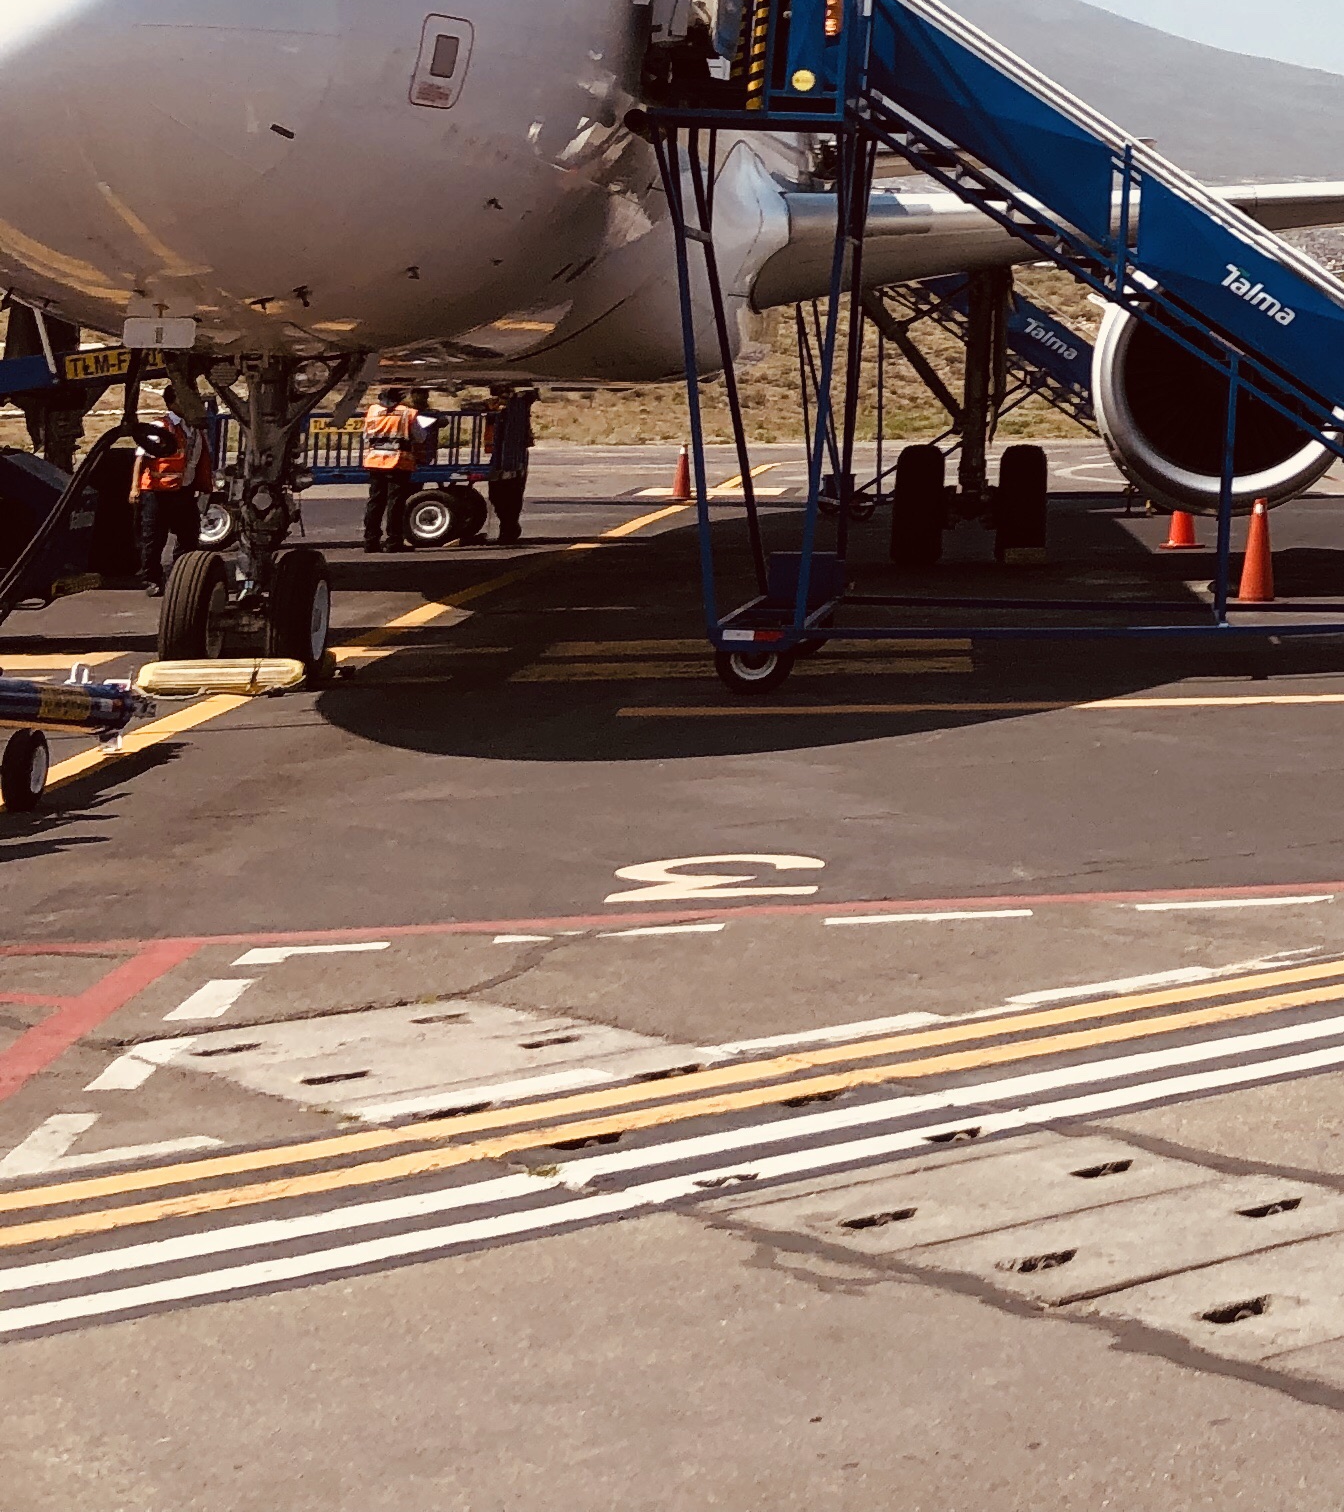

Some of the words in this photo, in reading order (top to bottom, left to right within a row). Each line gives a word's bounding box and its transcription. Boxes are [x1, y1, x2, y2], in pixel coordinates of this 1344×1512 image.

[1220, 263, 1296, 326] Talma
[1024, 317, 1078, 360] Talma
[604, 854, 826, 903] 3
